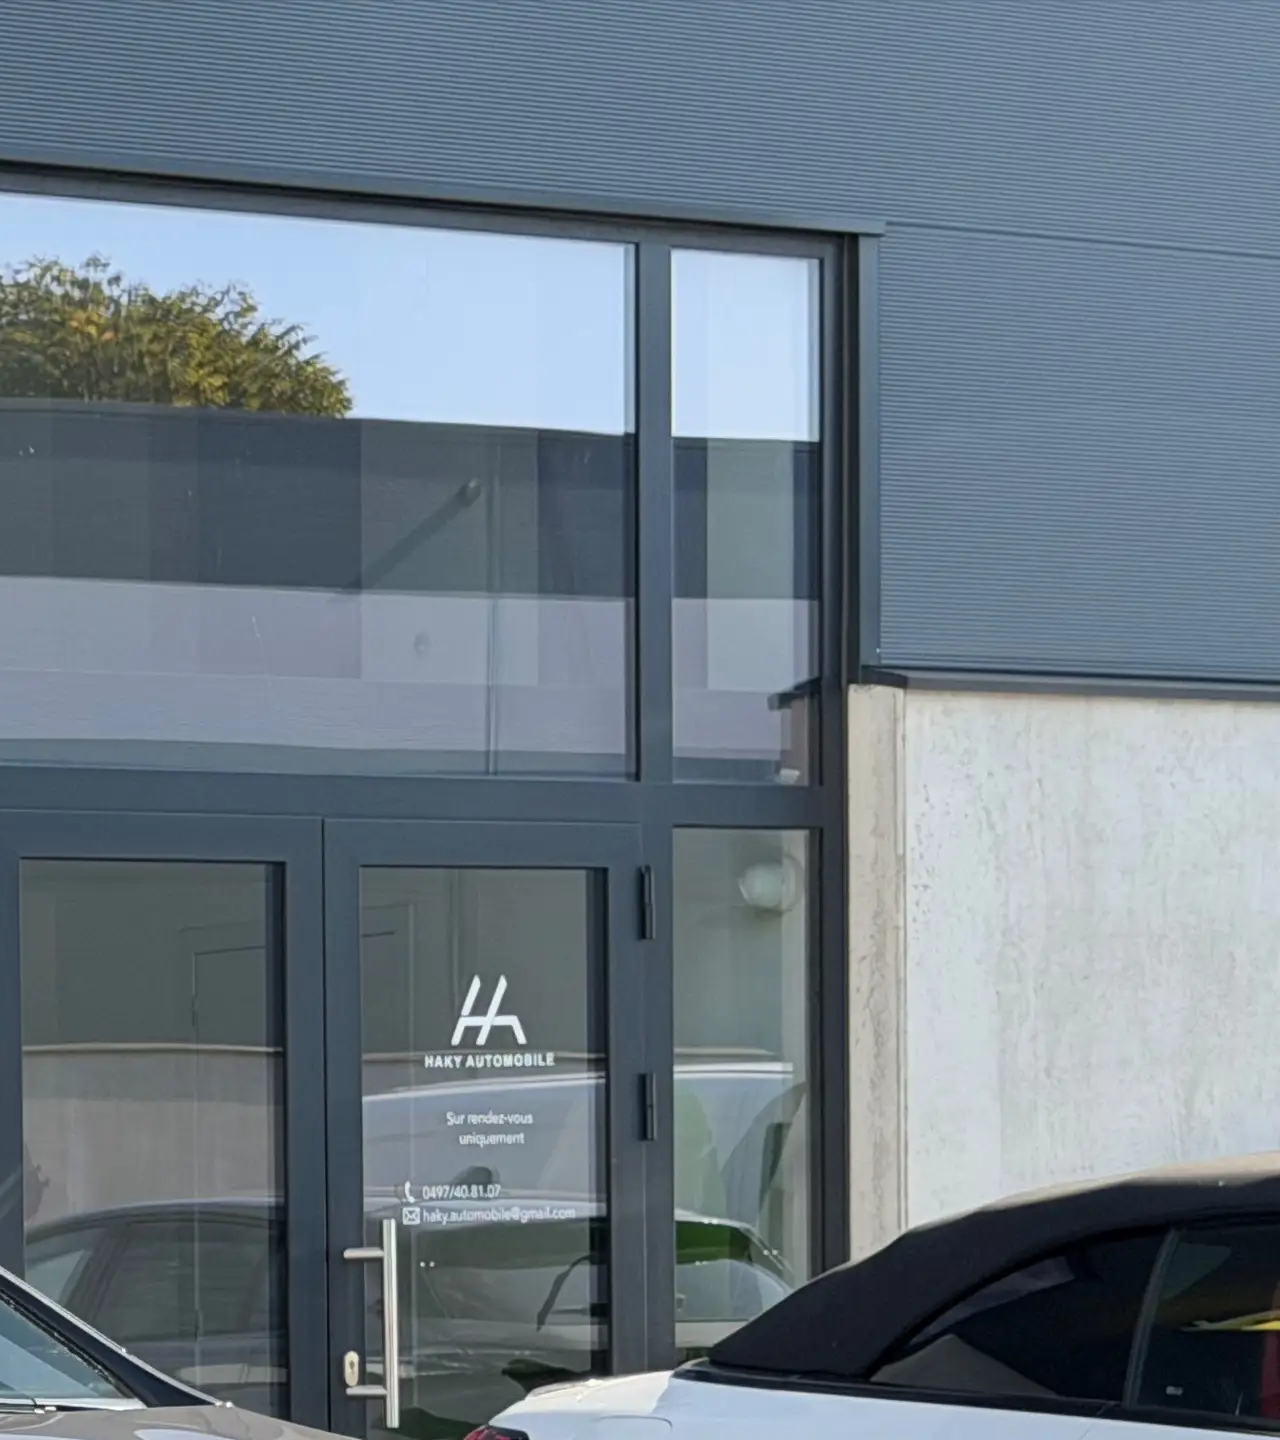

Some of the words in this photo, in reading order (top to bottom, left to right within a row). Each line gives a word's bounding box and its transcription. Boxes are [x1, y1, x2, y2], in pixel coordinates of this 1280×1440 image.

[424, 1055, 462, 1069] HAKY
[465, 1052, 555, 1068] AUTOMOBILE
[446, 1111, 464, 1126] Sur
[467, 1109, 534, 1125] rendez-vous
[459, 1132, 525, 1148] uniquement
[422, 1184, 502, 1200] 0497/40.81.07
[423, 1207, 576, 1225] haky.automobile@gmail.com
